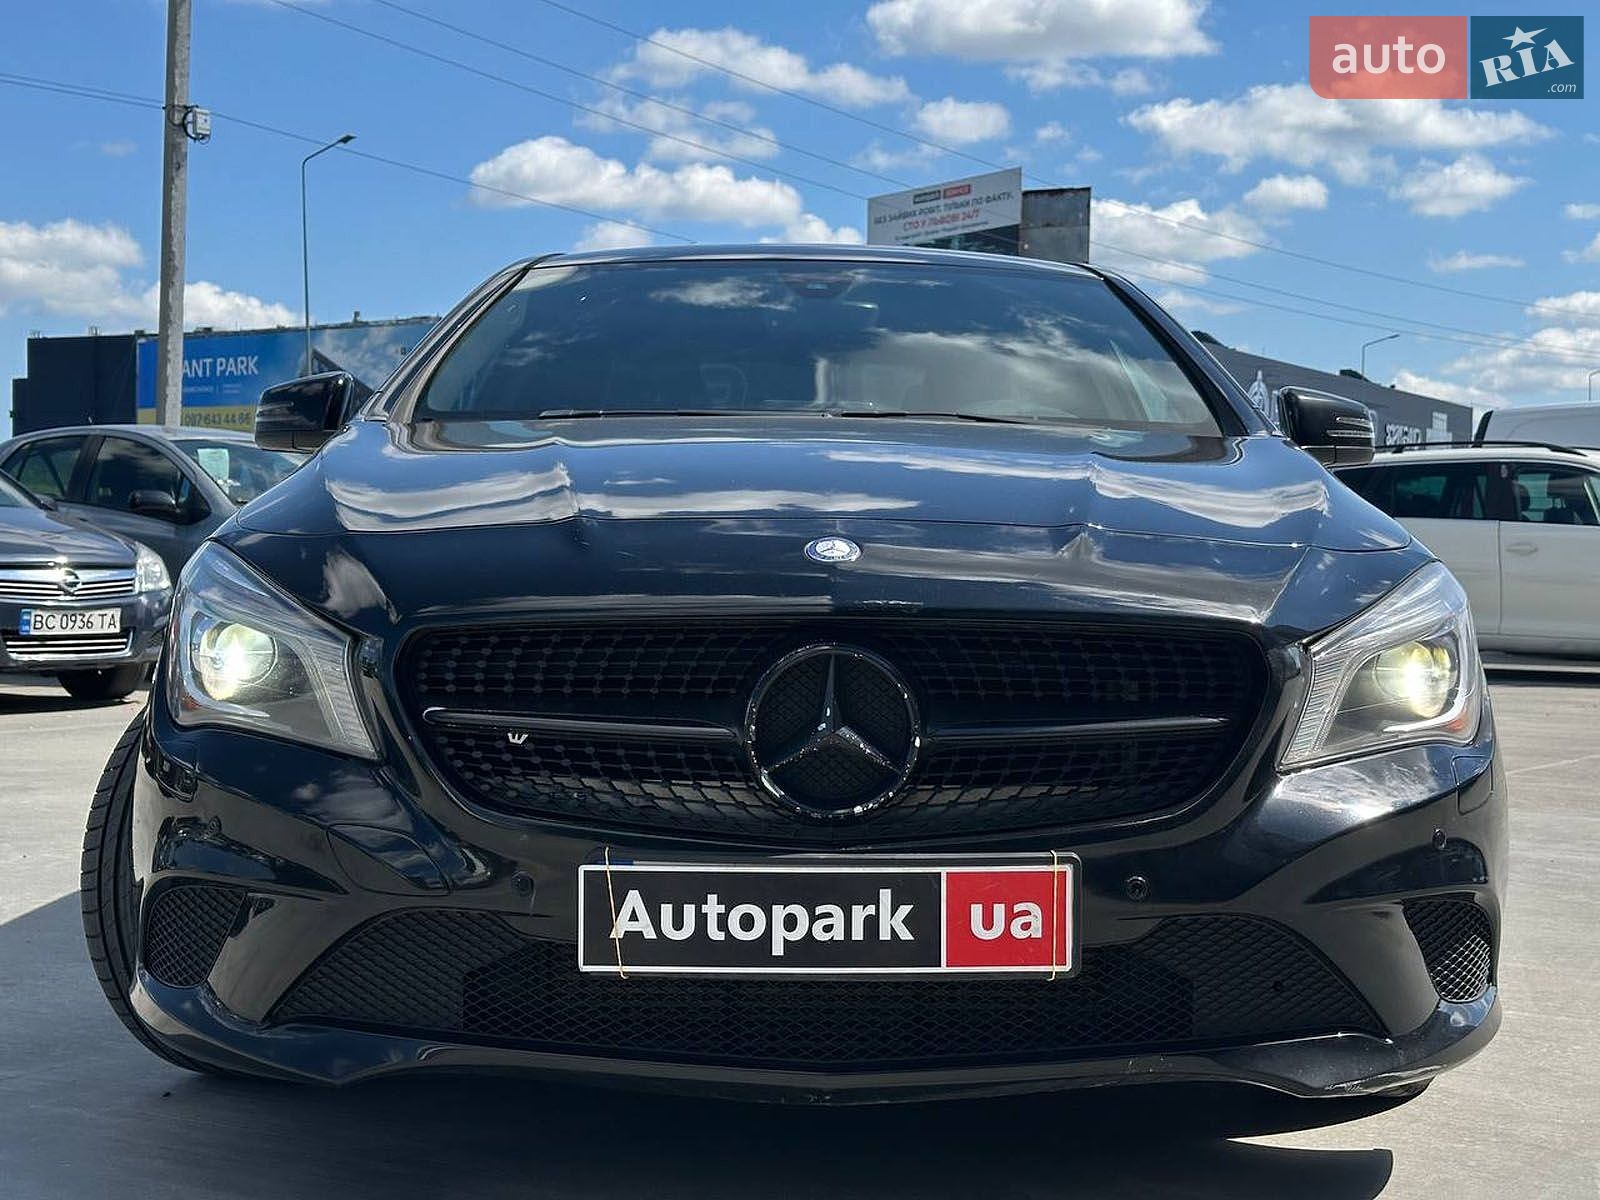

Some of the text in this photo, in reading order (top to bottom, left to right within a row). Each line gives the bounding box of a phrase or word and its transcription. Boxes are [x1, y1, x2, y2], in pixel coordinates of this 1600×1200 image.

[182, 356, 259, 379] ANT PARK
[33, 613, 117, 630] BC 0936 TA
[609, 889, 1043, 956] Autopark ua
